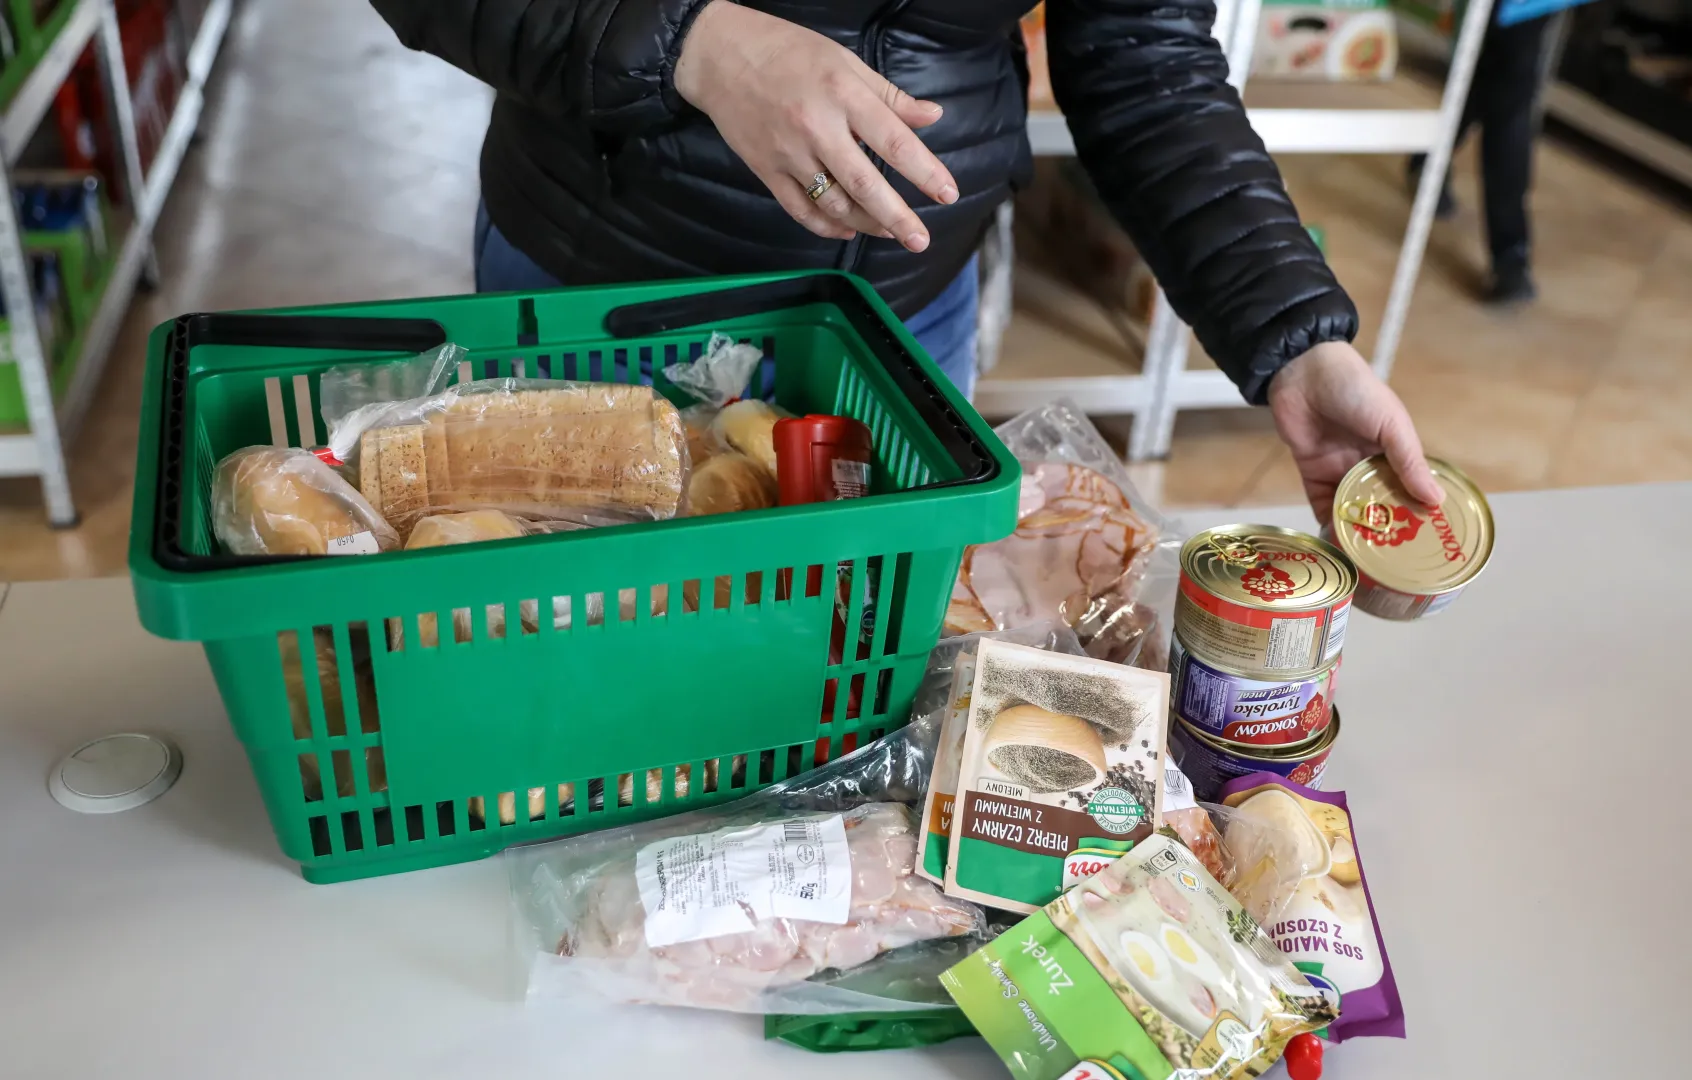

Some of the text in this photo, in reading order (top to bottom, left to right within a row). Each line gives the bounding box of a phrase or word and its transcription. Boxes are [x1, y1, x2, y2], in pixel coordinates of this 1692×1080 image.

[1232, 696, 1300, 718] Tyrolska
[1234, 715, 1299, 738] SOKOŁÓW
[985, 782, 1023, 796] MIELONY
[1094, 788, 1134, 805] POCHODZENIA
[974, 798, 1032, 821] WIETNAMU
[1036, 810, 1043, 823] Z
[1095, 804, 1137, 815] WIETNAM
[972, 817, 1023, 842] CZARNY
[1097, 815, 1134, 832] GWARANCJA
[1026, 828, 1069, 852] PIEPRZ
[1068, 861, 1109, 877] orr
[1333, 923, 1342, 940] Z
[1332, 941, 1364, 961] SOS
[1020, 934, 1074, 996] Żurek
[1017, 999, 1058, 1052] Ulubione
